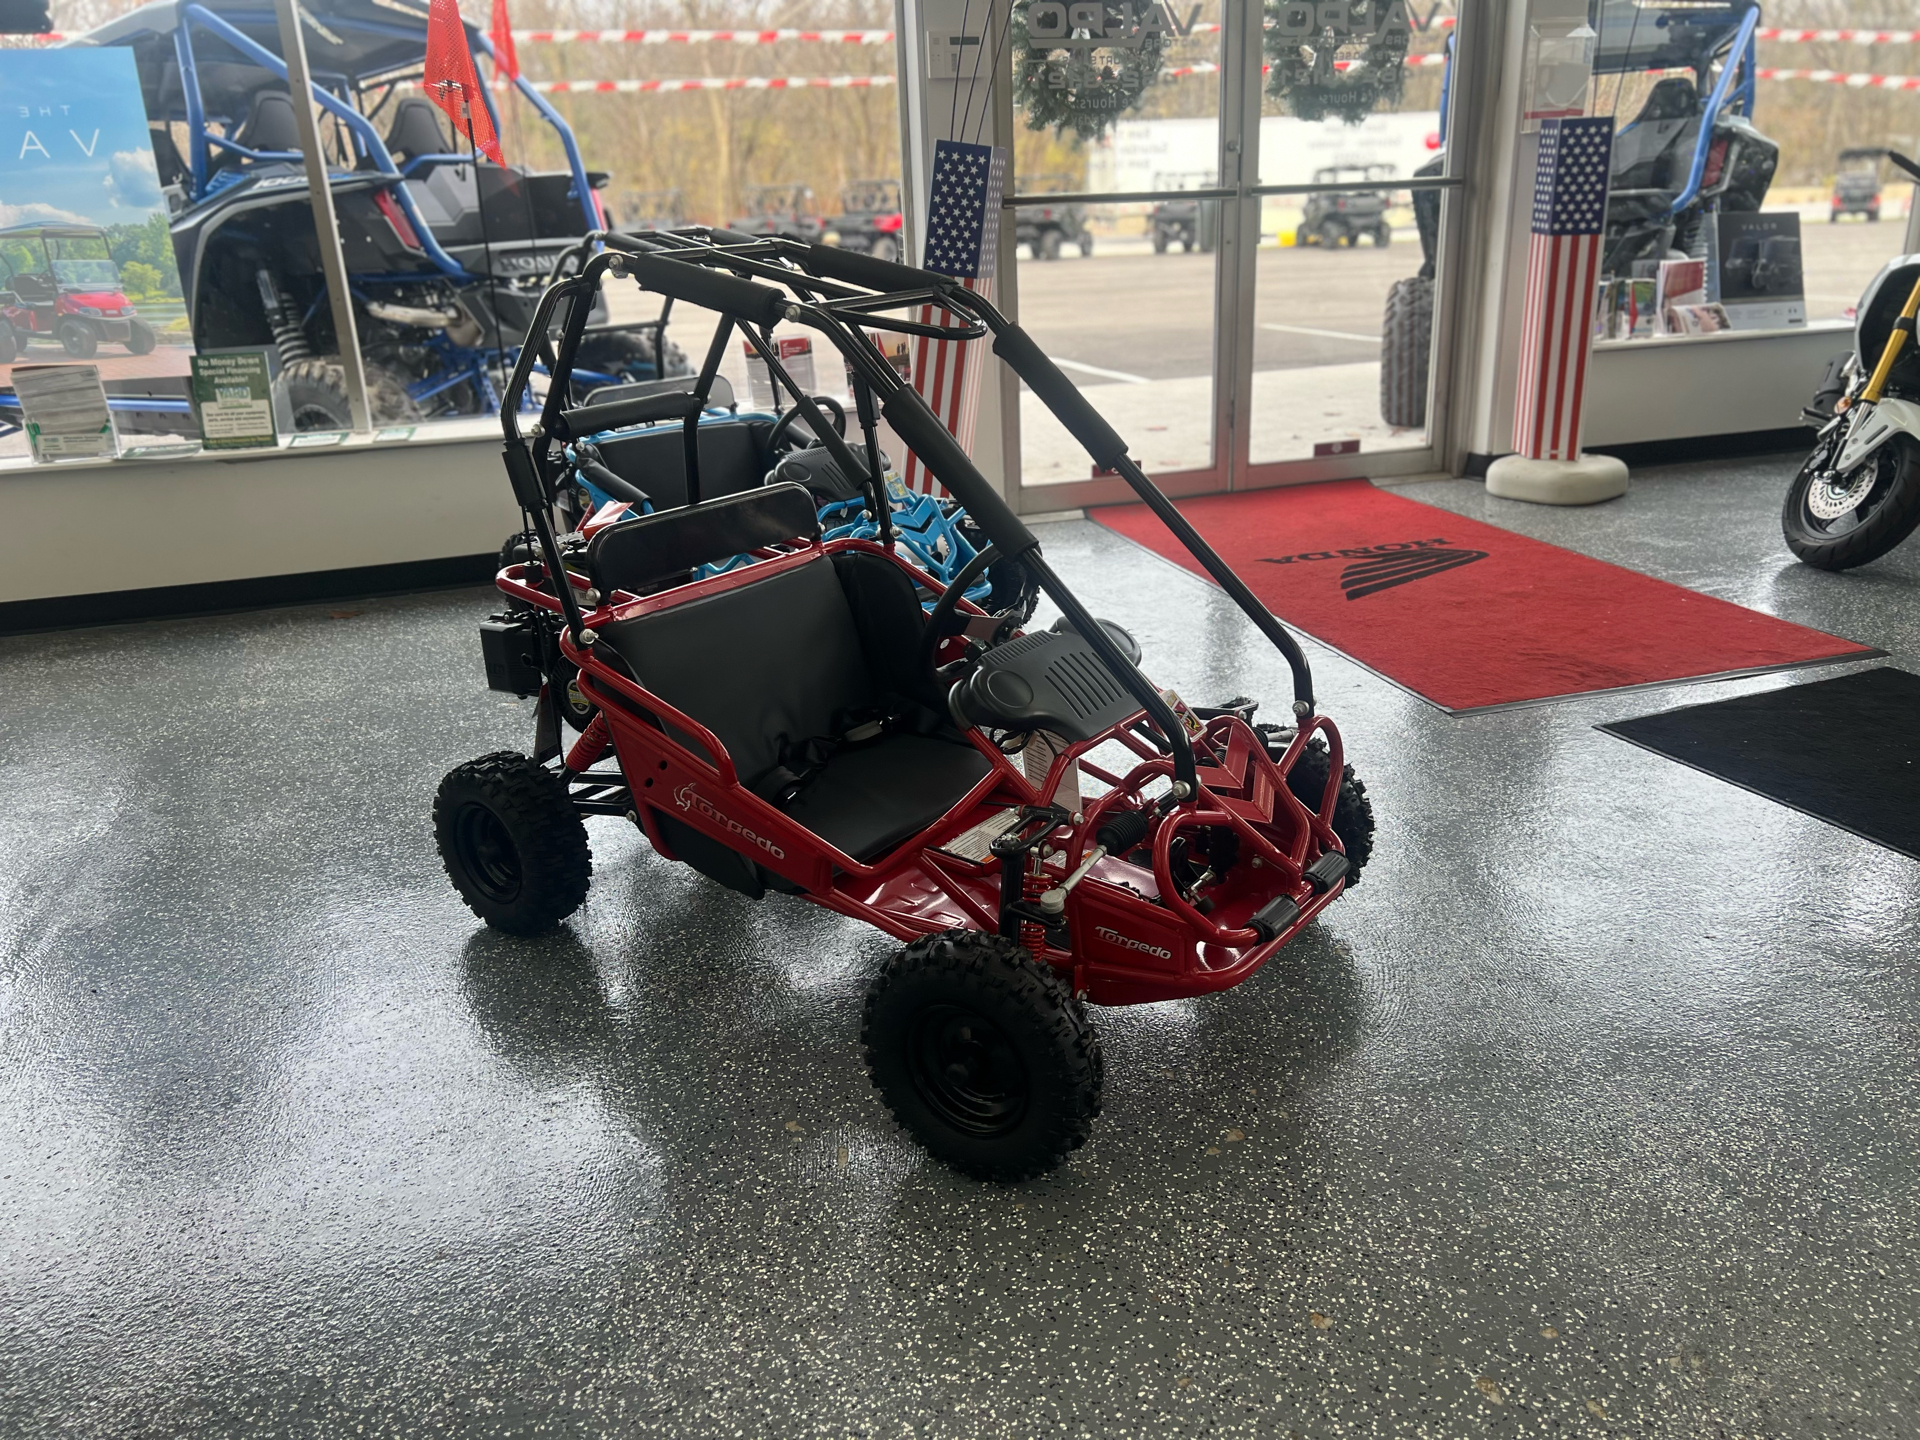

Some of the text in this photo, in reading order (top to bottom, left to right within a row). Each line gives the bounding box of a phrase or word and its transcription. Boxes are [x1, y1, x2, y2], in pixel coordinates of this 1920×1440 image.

[501, 254, 579, 273] HONA
[197, 356, 260, 367] No Money Down
[199, 366, 261, 376] Special Financing
[1254, 537, 1454, 565] HONDA
[683, 788, 785, 860] Torpedo
[1094, 925, 1172, 960] Torpedo
